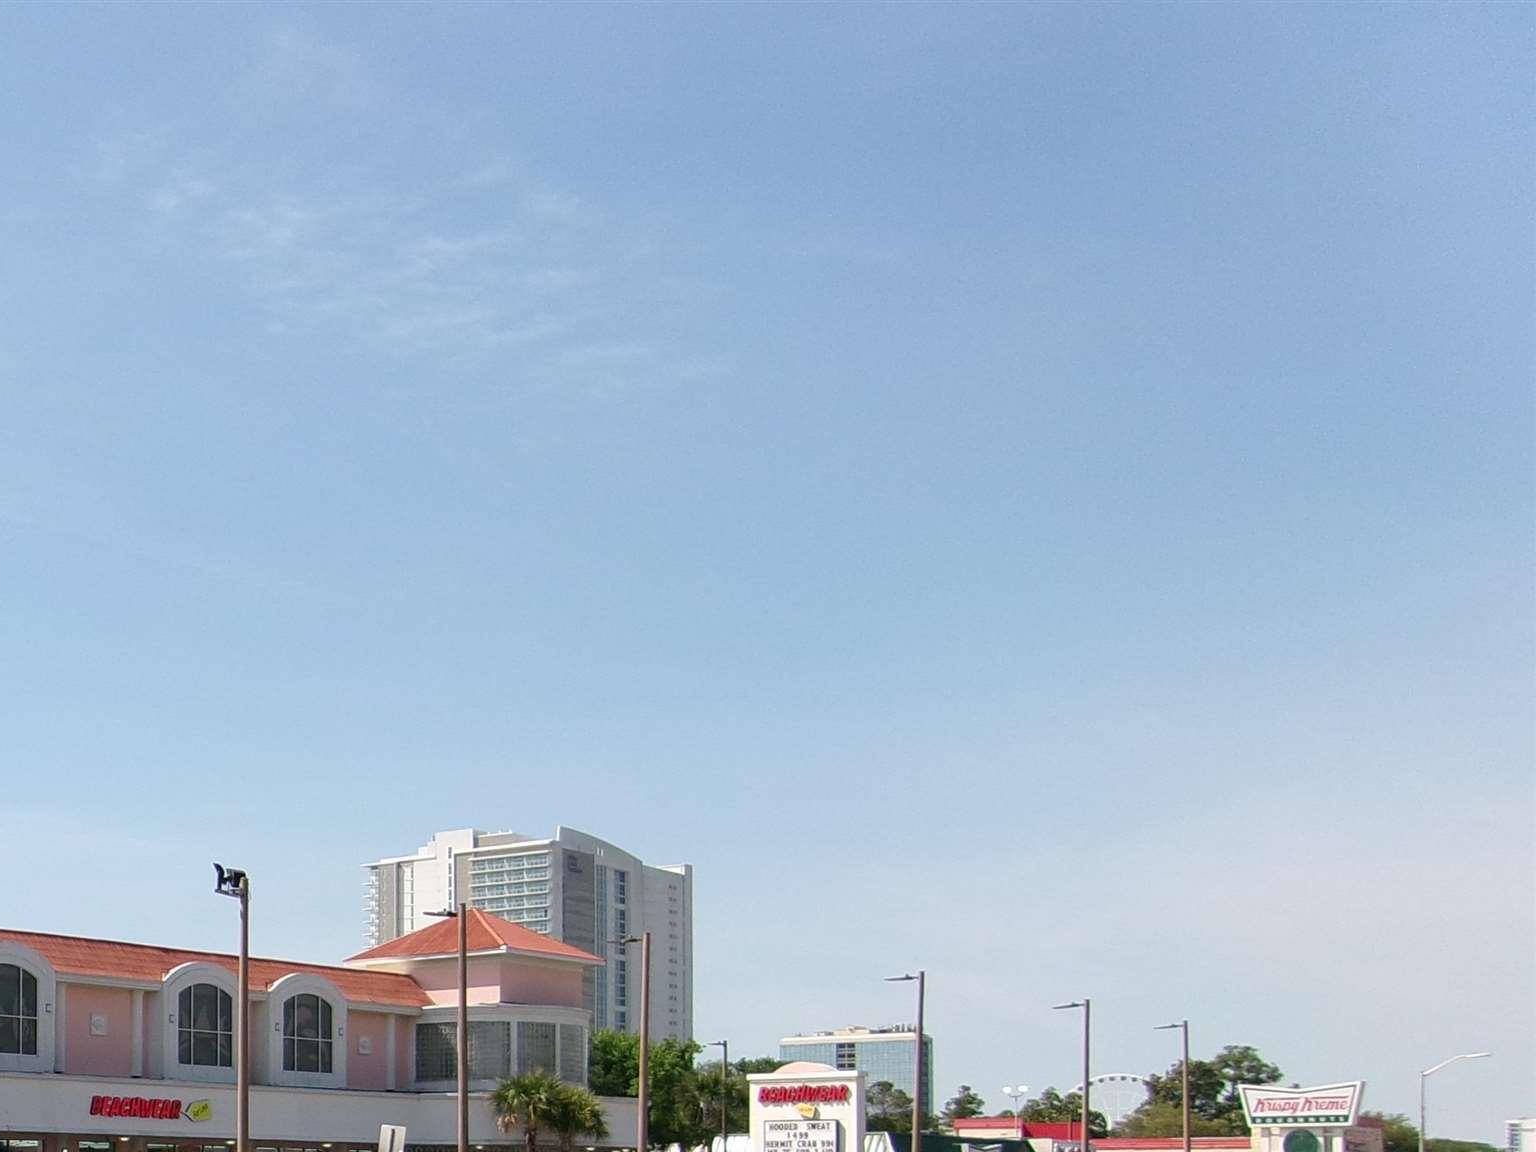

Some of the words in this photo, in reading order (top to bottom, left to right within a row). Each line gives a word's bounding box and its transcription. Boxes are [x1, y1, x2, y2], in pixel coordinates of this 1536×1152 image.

[758, 1083, 850, 1104] BEACHWEAR
[90, 1095, 182, 1120] BEACHWEAR
[1253, 1098, 1301, 1114] Krispy
[1301, 1096, 1349, 1112] Kreme
[806, 1122, 831, 1130] SWEAT
[1254, 1115, 1345, 1124] DOUGHNUTS
[766, 1140, 793, 1148] HERMIT
[796, 1140, 817, 1148] CRAB
